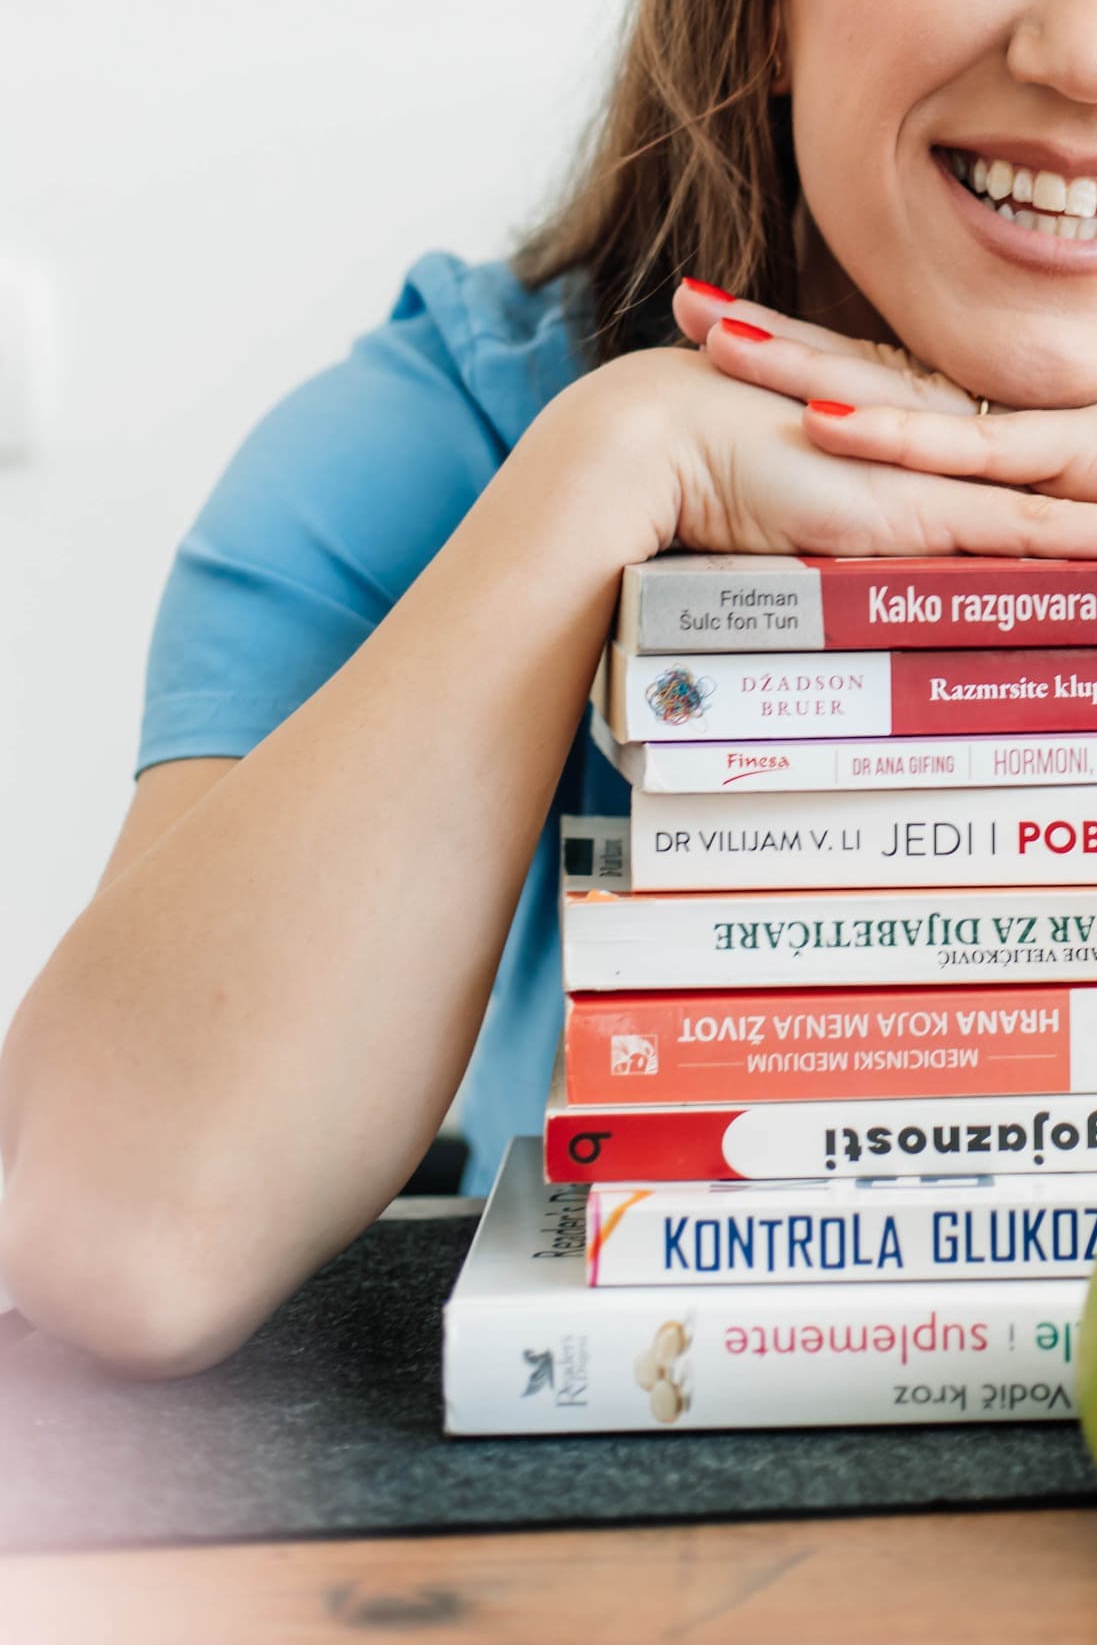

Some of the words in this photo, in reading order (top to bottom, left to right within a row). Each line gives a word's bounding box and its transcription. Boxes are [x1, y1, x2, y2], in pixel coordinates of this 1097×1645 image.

[718, 589, 800, 608] Fridman
[867, 585, 944, 624] Kako
[677, 610, 722, 632] Šulc
[727, 611, 758, 630] fon
[763, 611, 800, 632] Tun
[738, 673, 867, 693] DŽADSON
[928, 677, 1050, 702] Razmrsite
[760, 699, 846, 718] BRUER
[726, 751, 790, 770] Finesa
[851, 759, 872, 777] DR
[876, 758, 904, 777] ANA
[908, 756, 956, 775] GIFING
[992, 747, 1095, 777] HORMONI,
[655, 830, 690, 853] DR
[698, 829, 803, 853] VILIJAM
[809, 828, 833, 852] V.
[841, 827, 863, 852] LI
[880, 821, 974, 856] JEDI
[988, 822, 998, 855] I
[712, 910, 982, 959] DIJABETIČARE
[992, 915, 1038, 944] ZA
[936, 946, 1057, 970] VELIČKOVIĆ
[676, 1016, 769, 1047] ŽIVOT
[774, 1012, 871, 1041] MENJA
[877, 1010, 950, 1038] KOJA
[956, 1007, 1061, 1035] HRANA
[745, 1049, 849, 1074] MEDIJUM
[853, 1047, 980, 1069] MEDICINSKI
[662, 1211, 906, 1274] KONTROLA
[723, 1309, 990, 1367] suplemente
[892, 1381, 968, 1412] kroz
[978, 1381, 1073, 1412] Vodič
